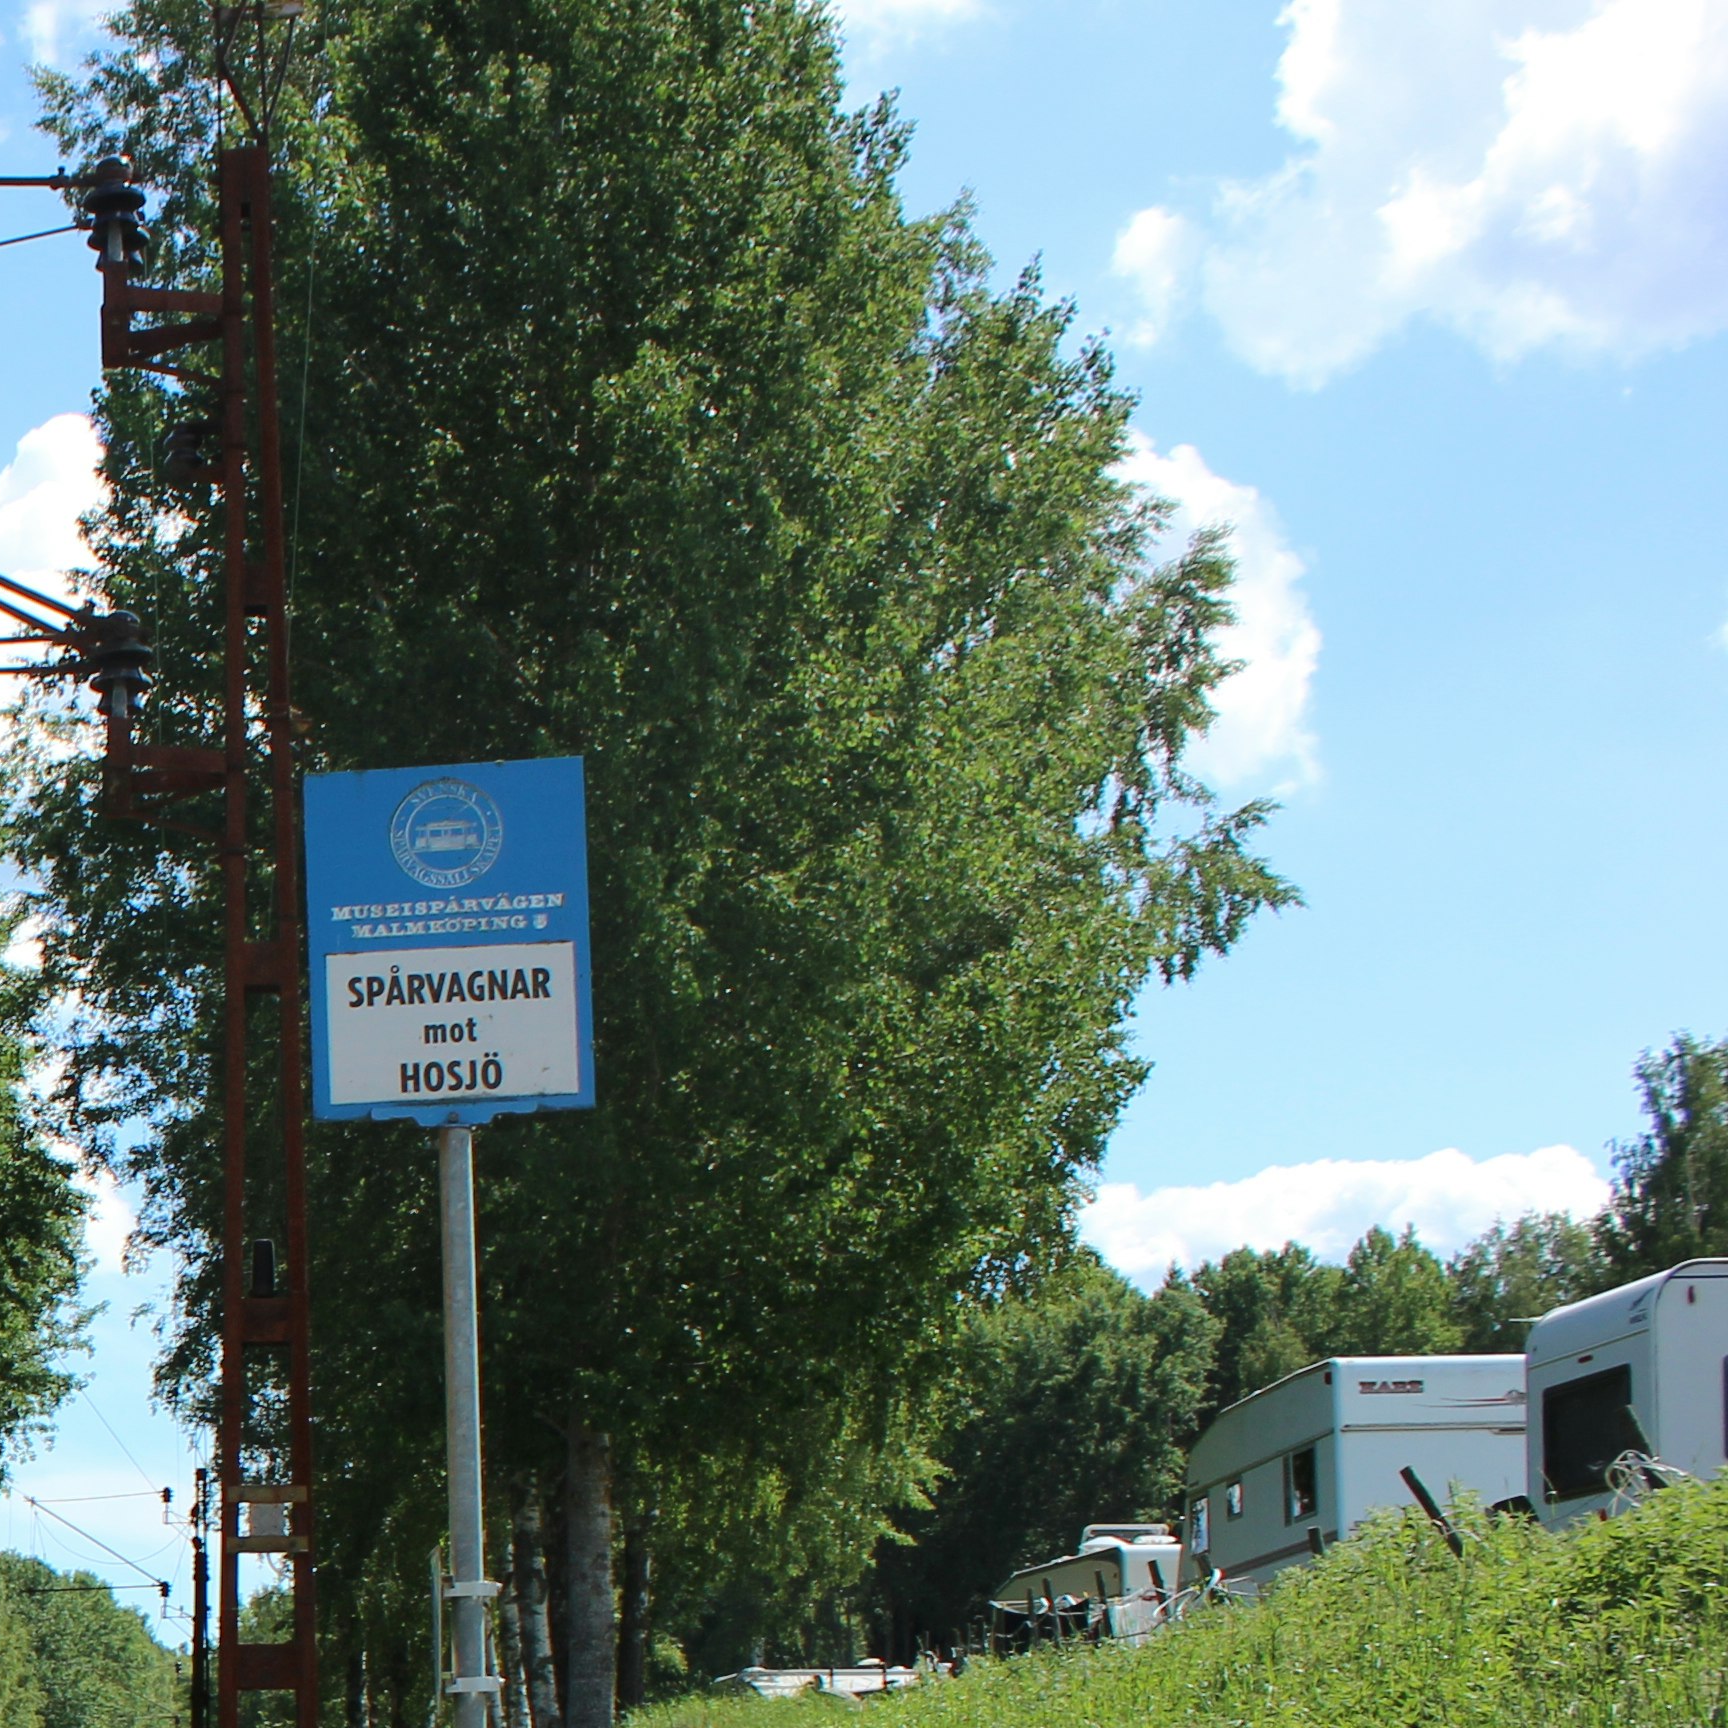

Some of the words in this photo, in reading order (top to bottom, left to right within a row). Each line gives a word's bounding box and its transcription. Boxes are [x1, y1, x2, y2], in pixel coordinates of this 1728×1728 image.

[331, 892, 564, 921] MUSEISPÅRVÄGEN
[351, 914, 527, 938] MALMKÖPING
[347, 965, 551, 1008] SPÅRVAGNAR
[424, 1018, 477, 1044] mot
[400, 1052, 502, 1093] HOSJÖ
